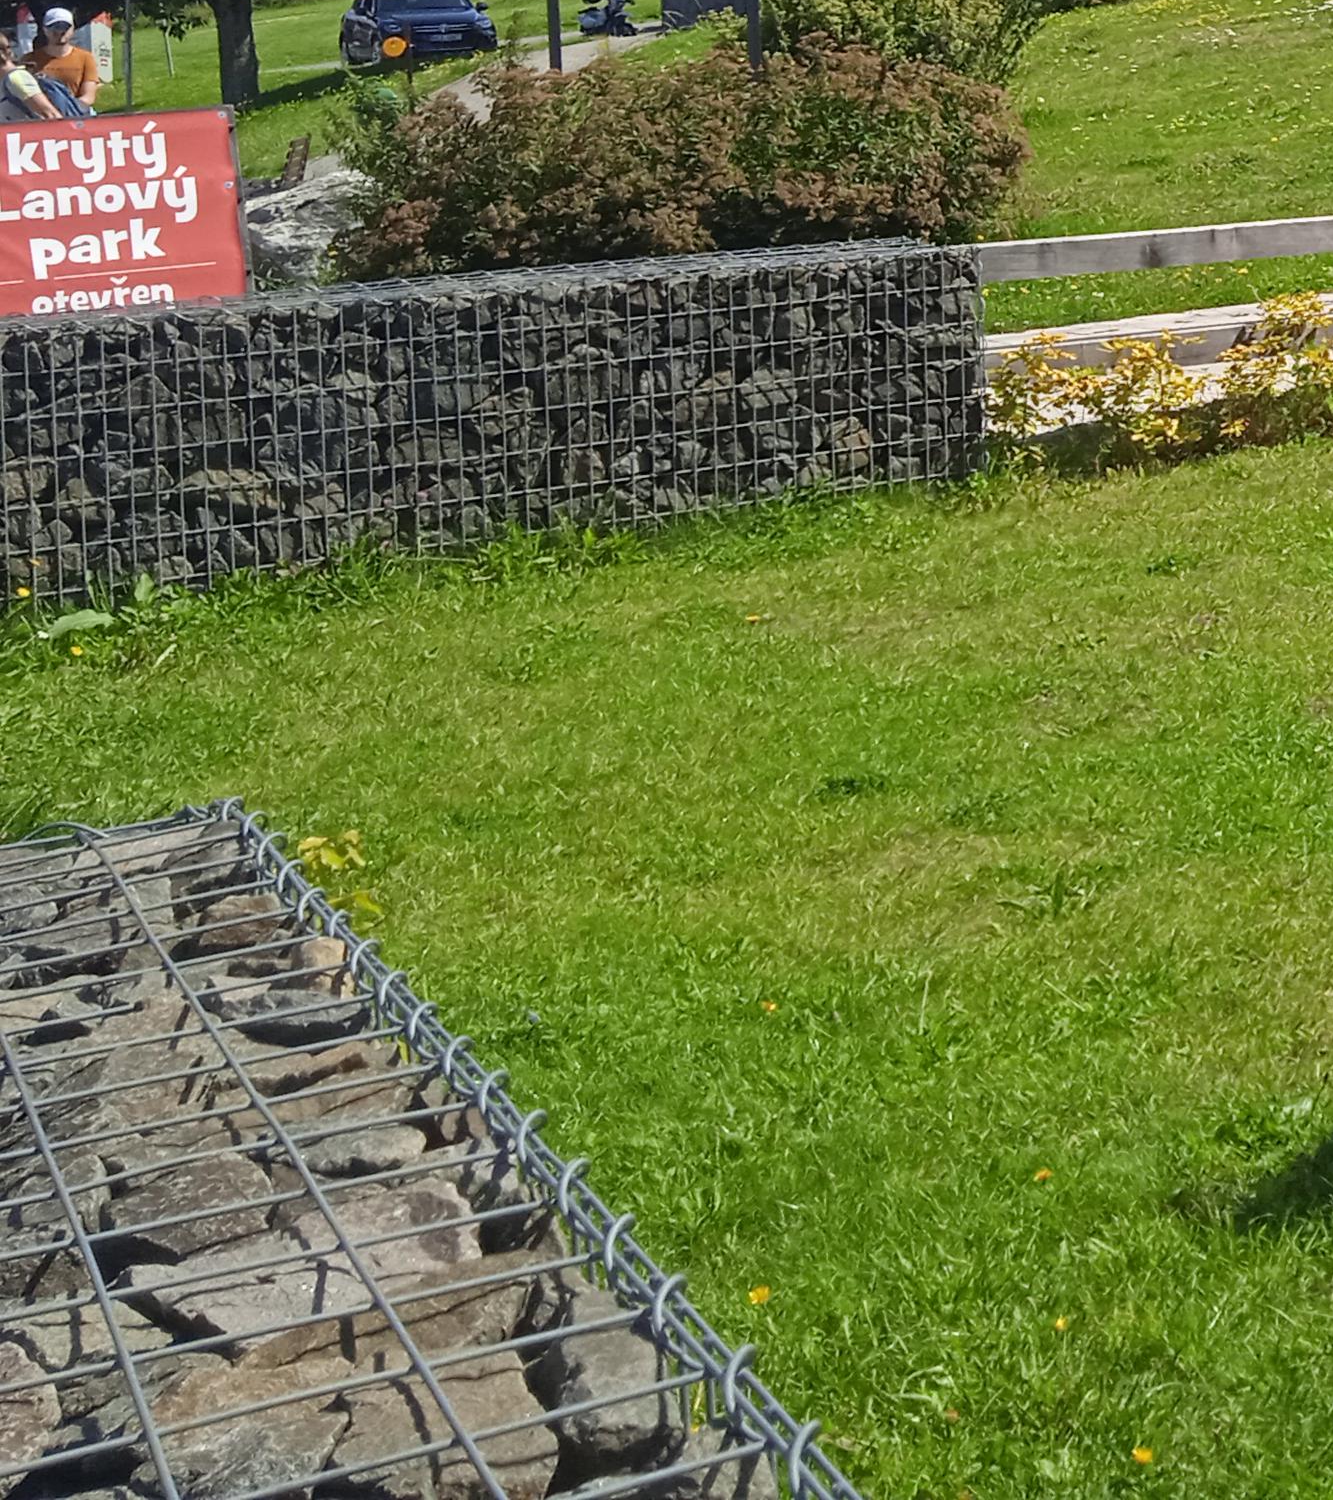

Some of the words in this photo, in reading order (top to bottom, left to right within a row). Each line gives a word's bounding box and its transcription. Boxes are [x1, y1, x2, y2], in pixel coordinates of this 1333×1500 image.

[6, 121, 167, 184] krytý
[29, 218, 166, 280] park
[32, 276, 176, 315] otevřen
